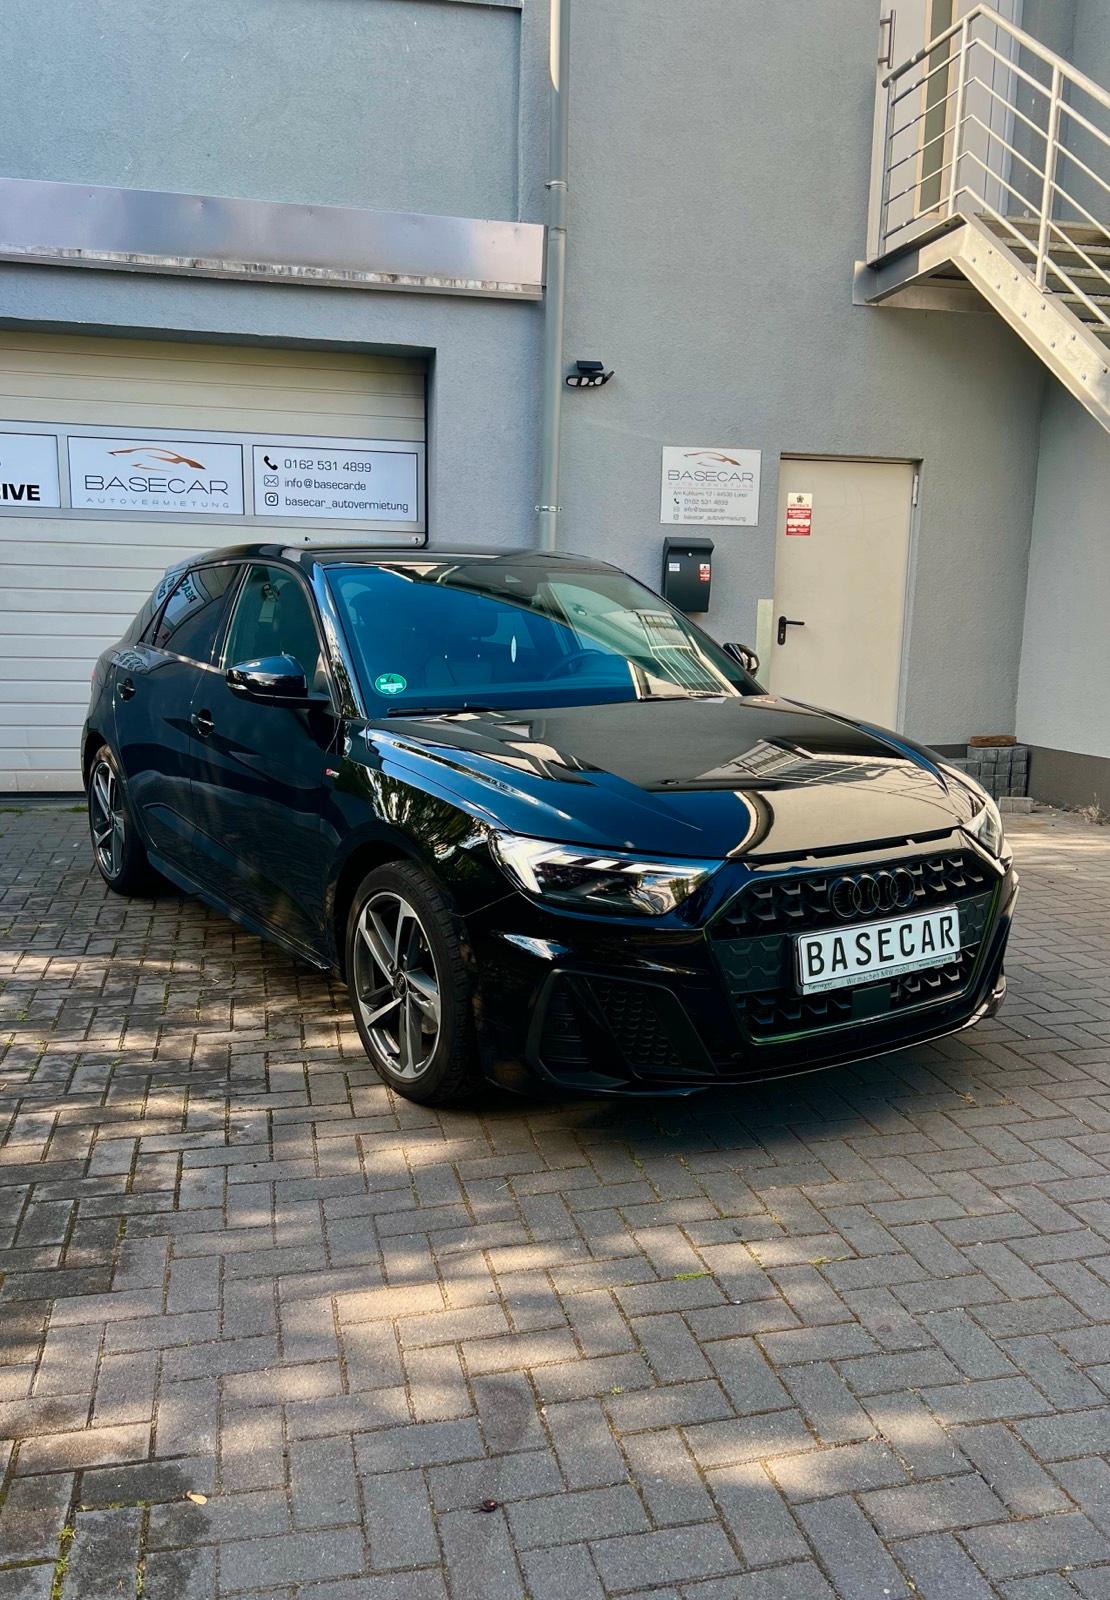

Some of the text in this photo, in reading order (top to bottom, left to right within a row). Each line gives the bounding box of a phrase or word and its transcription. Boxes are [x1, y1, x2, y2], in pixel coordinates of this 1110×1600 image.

[284, 458, 372, 473] 0162 531 4899
[668, 469, 754, 482] BASECAR
[0, 483, 41, 501] IVE
[84, 474, 229, 496] BASECAR
[86, 497, 230, 509] AUTOVERMIETUNG
[285, 496, 409, 513] basecar_autovermietung
[806, 915, 955, 977] BASECAR
